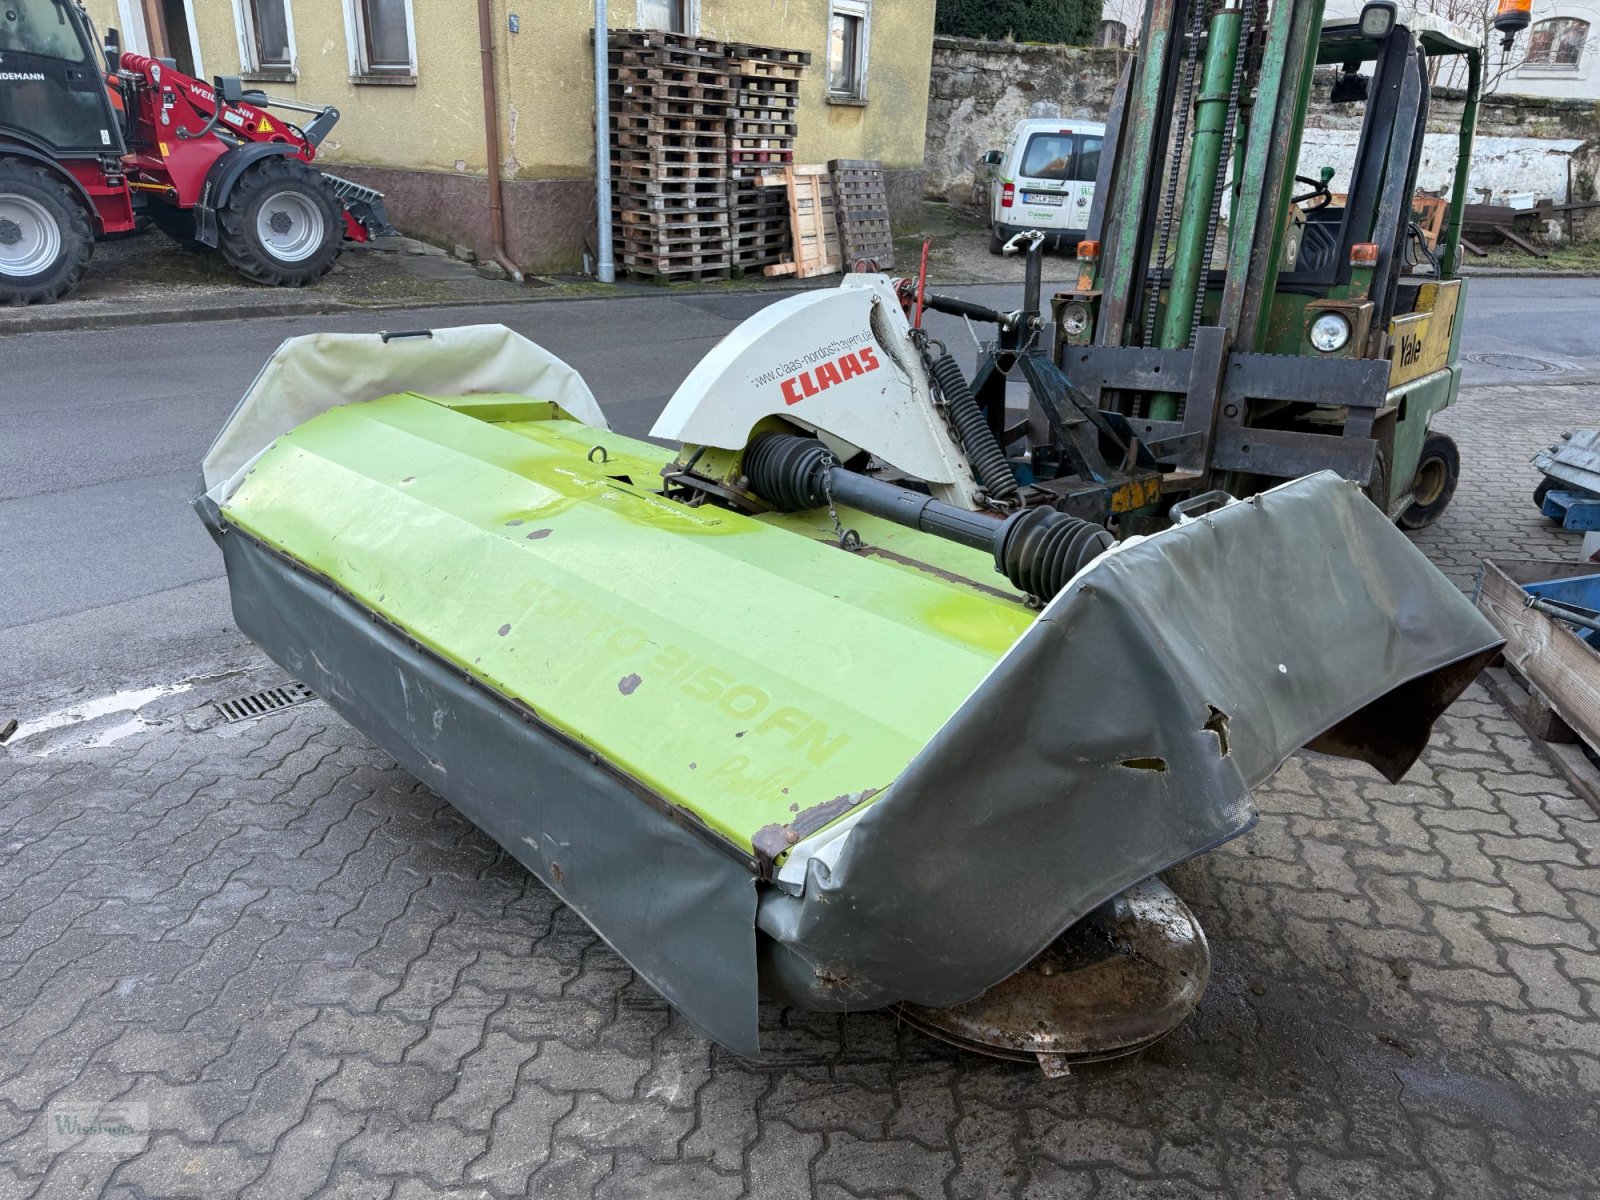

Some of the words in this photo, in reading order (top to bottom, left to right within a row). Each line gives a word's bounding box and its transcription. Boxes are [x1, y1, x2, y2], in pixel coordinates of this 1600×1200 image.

[748, 329, 874, 388] ww.claas-nordostbayern.de
[780, 346, 880, 406] CLAAS
[1400, 333, 1422, 367] Yale
